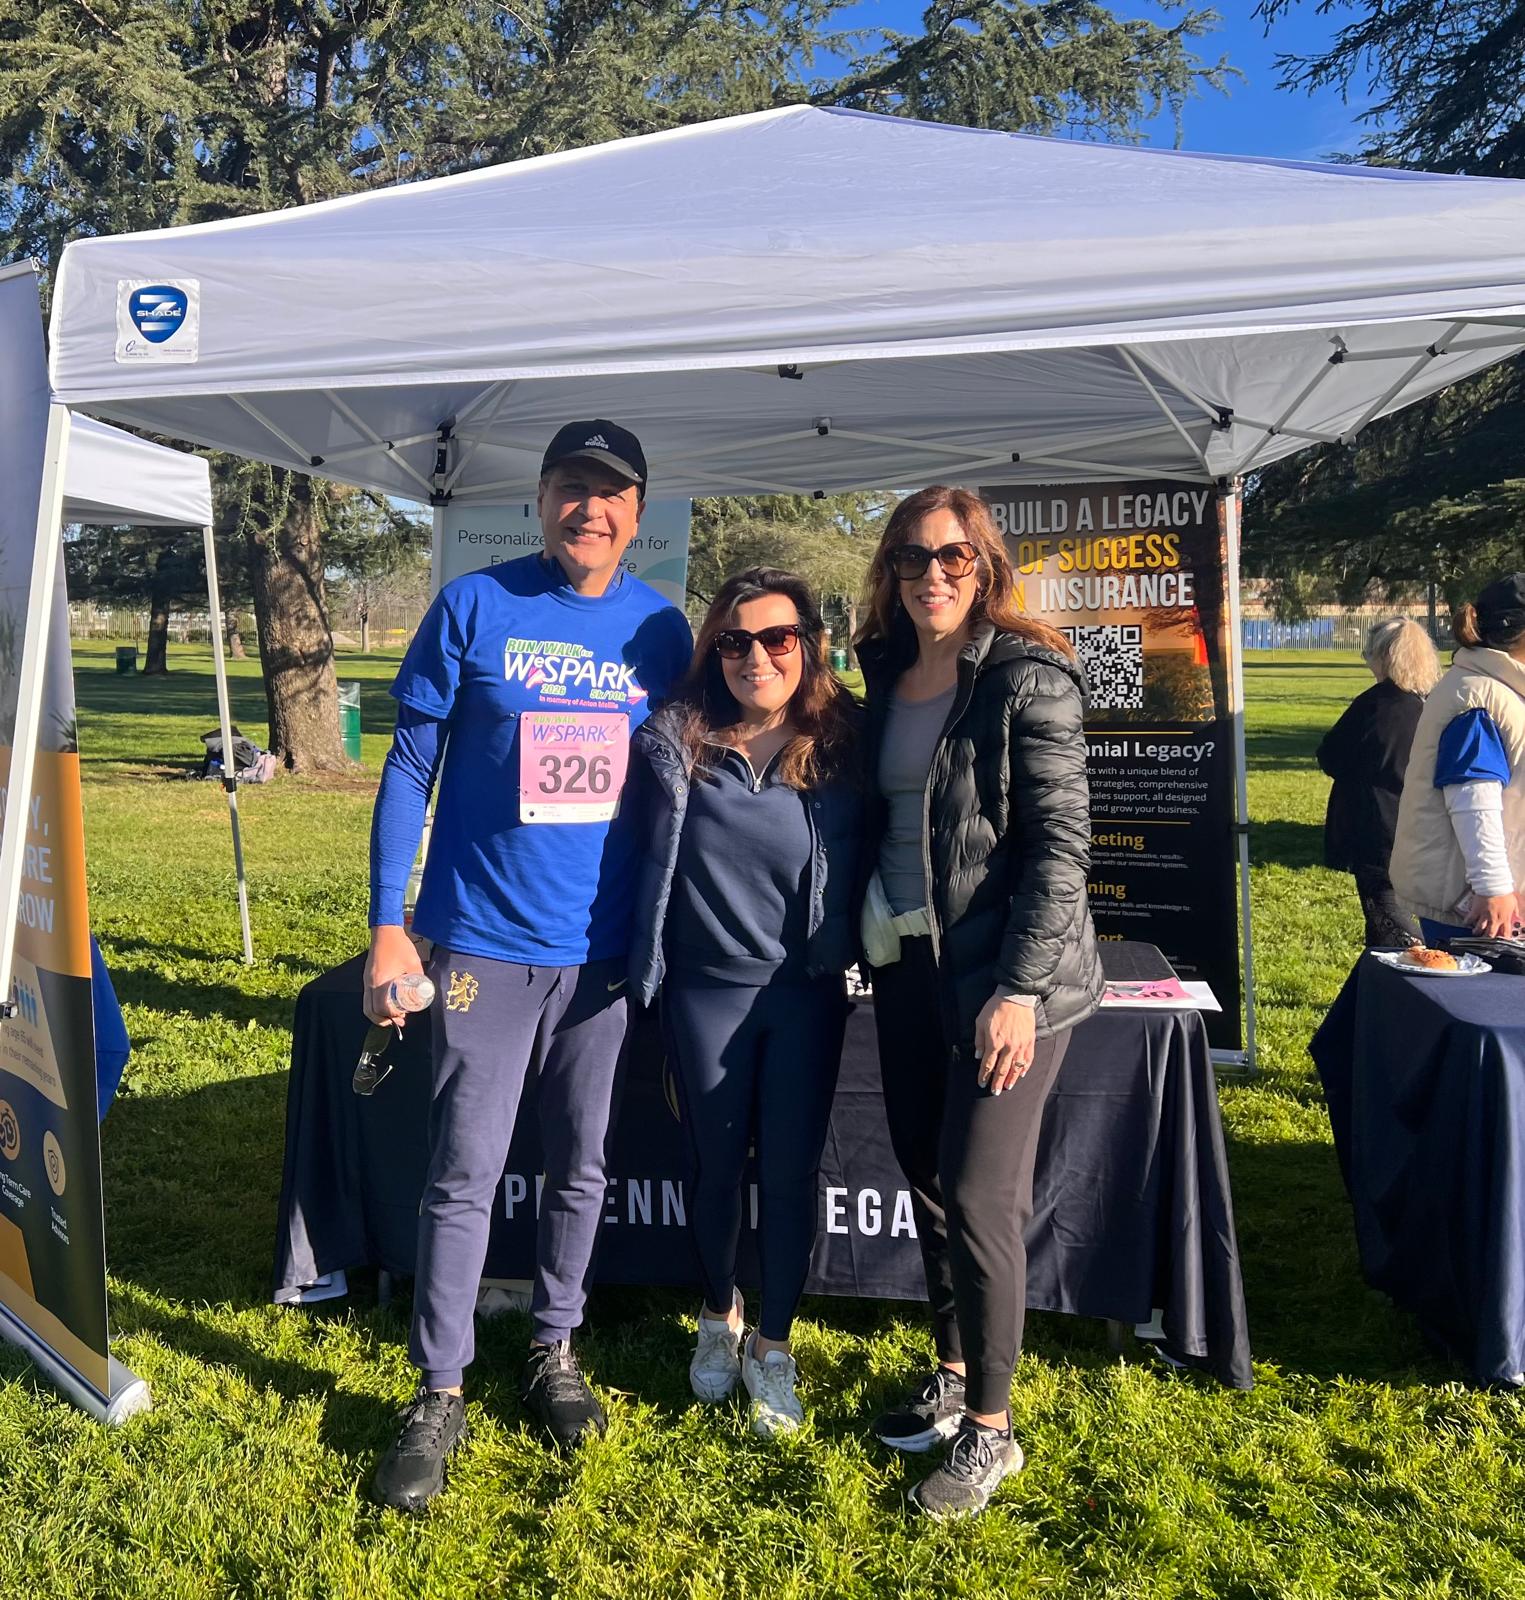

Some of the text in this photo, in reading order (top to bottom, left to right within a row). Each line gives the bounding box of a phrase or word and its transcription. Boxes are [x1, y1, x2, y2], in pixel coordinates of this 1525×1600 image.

[136, 309, 181, 317] SHADE
[585, 441, 608, 449] adidas
[990, 490, 1209, 536] BUILD A LEGACY
[458, 530, 545, 546] Personalize
[648, 536, 669, 549] for
[1018, 533, 1182, 574] OF SUCCESS
[1041, 573, 1194, 611] INSURANCE
[504, 653, 637, 690] WeSPARK
[541, 683, 626, 702] 2026 5k/10k
[546, 697, 571, 706] memory
[532, 724, 610, 742] WeSPARK
[1135, 741, 1215, 762] Legacy?
[538, 755, 611, 794] 326
[1098, 767, 1117, 775] with
[1127, 768, 1158, 777] unique
[1160, 767, 1186, 776] blend
[1189, 767, 1199, 776] of
[1092, 781, 1209, 790] strategies, comprehensive
[1088, 792, 1206, 803] sales support, all designed
[1092, 804, 1200, 814] and grow your business.
[1090, 832, 1144, 850] keting
[1088, 880, 1127, 899] ning
